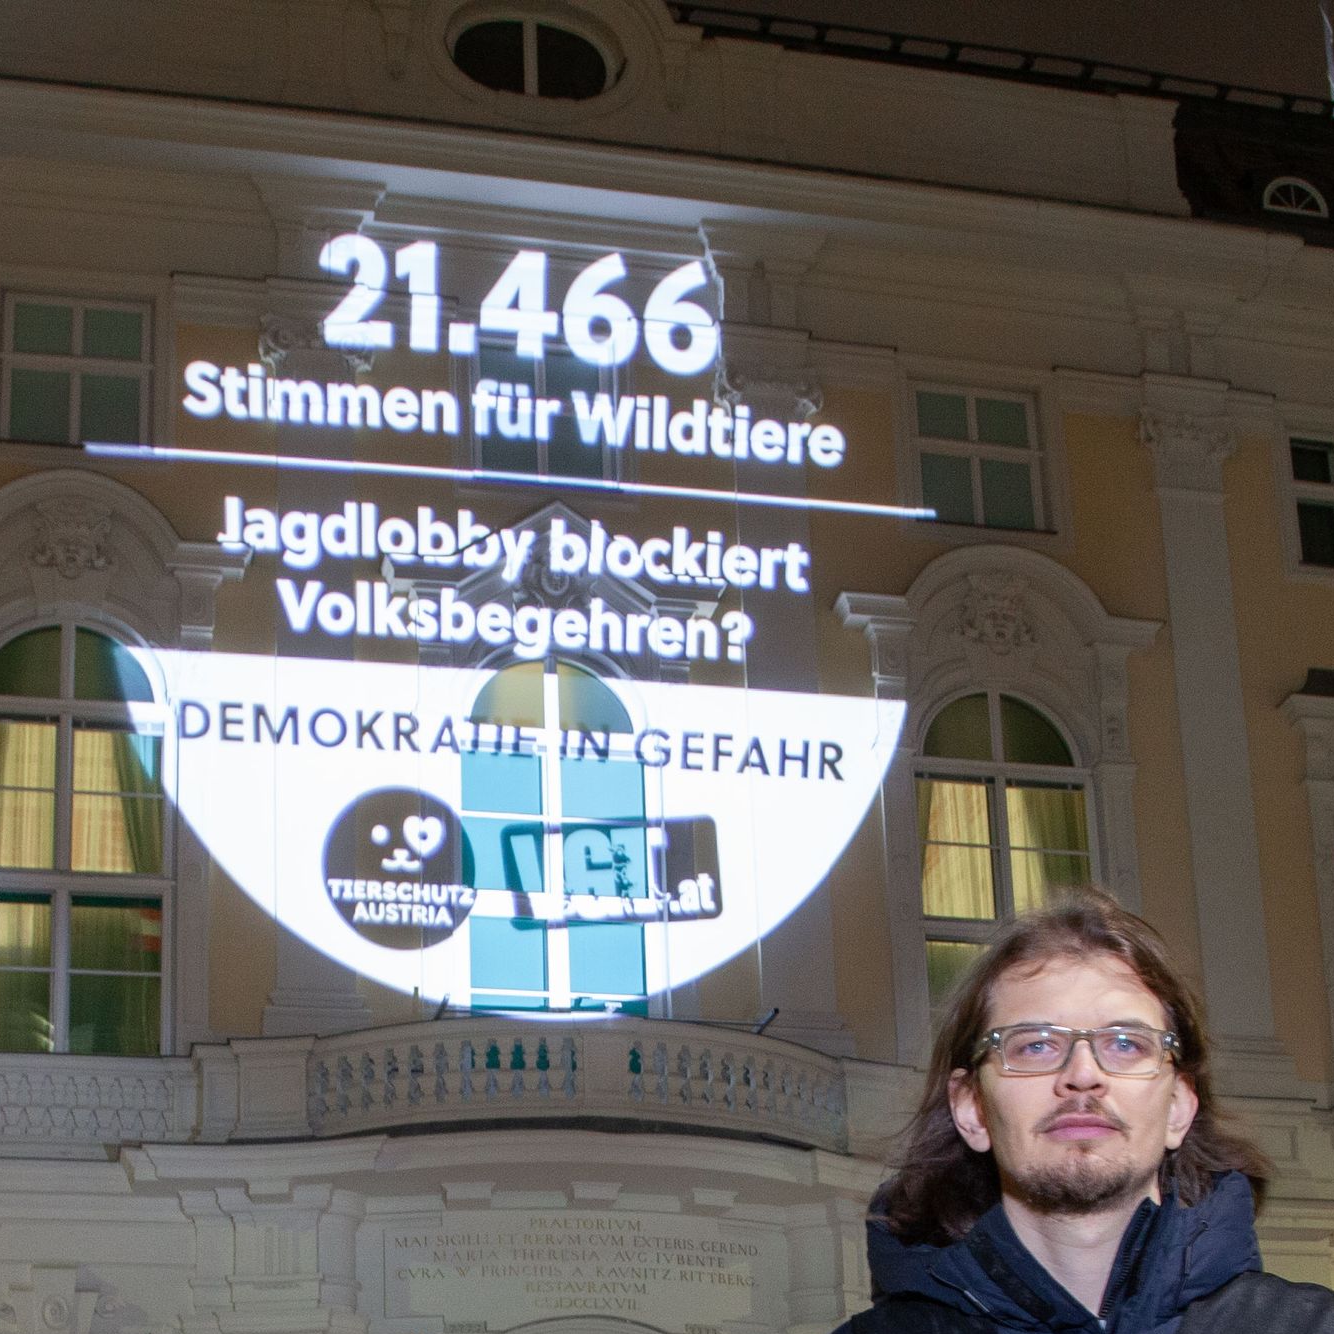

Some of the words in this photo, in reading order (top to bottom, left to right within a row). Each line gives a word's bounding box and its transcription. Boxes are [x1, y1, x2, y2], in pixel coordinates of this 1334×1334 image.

[319, 232, 722, 376] 21.466
[183, 361, 460, 438] Stimmen
[471, 382, 560, 443] für
[572, 389, 847, 468] Wildtiere
[217, 496, 535, 583] Jagdlobby
[552, 525, 810, 594] blockiert
[275, 579, 756, 662] Volksbegehren?
[179, 700, 538, 759] DEMOKRATIE
[559, 722, 611, 763] IN
[634, 729, 846, 782] GEFAHR
[327, 878, 475, 907] TIERSCHUTZ
[353, 901, 453, 927] AUSTRIA
